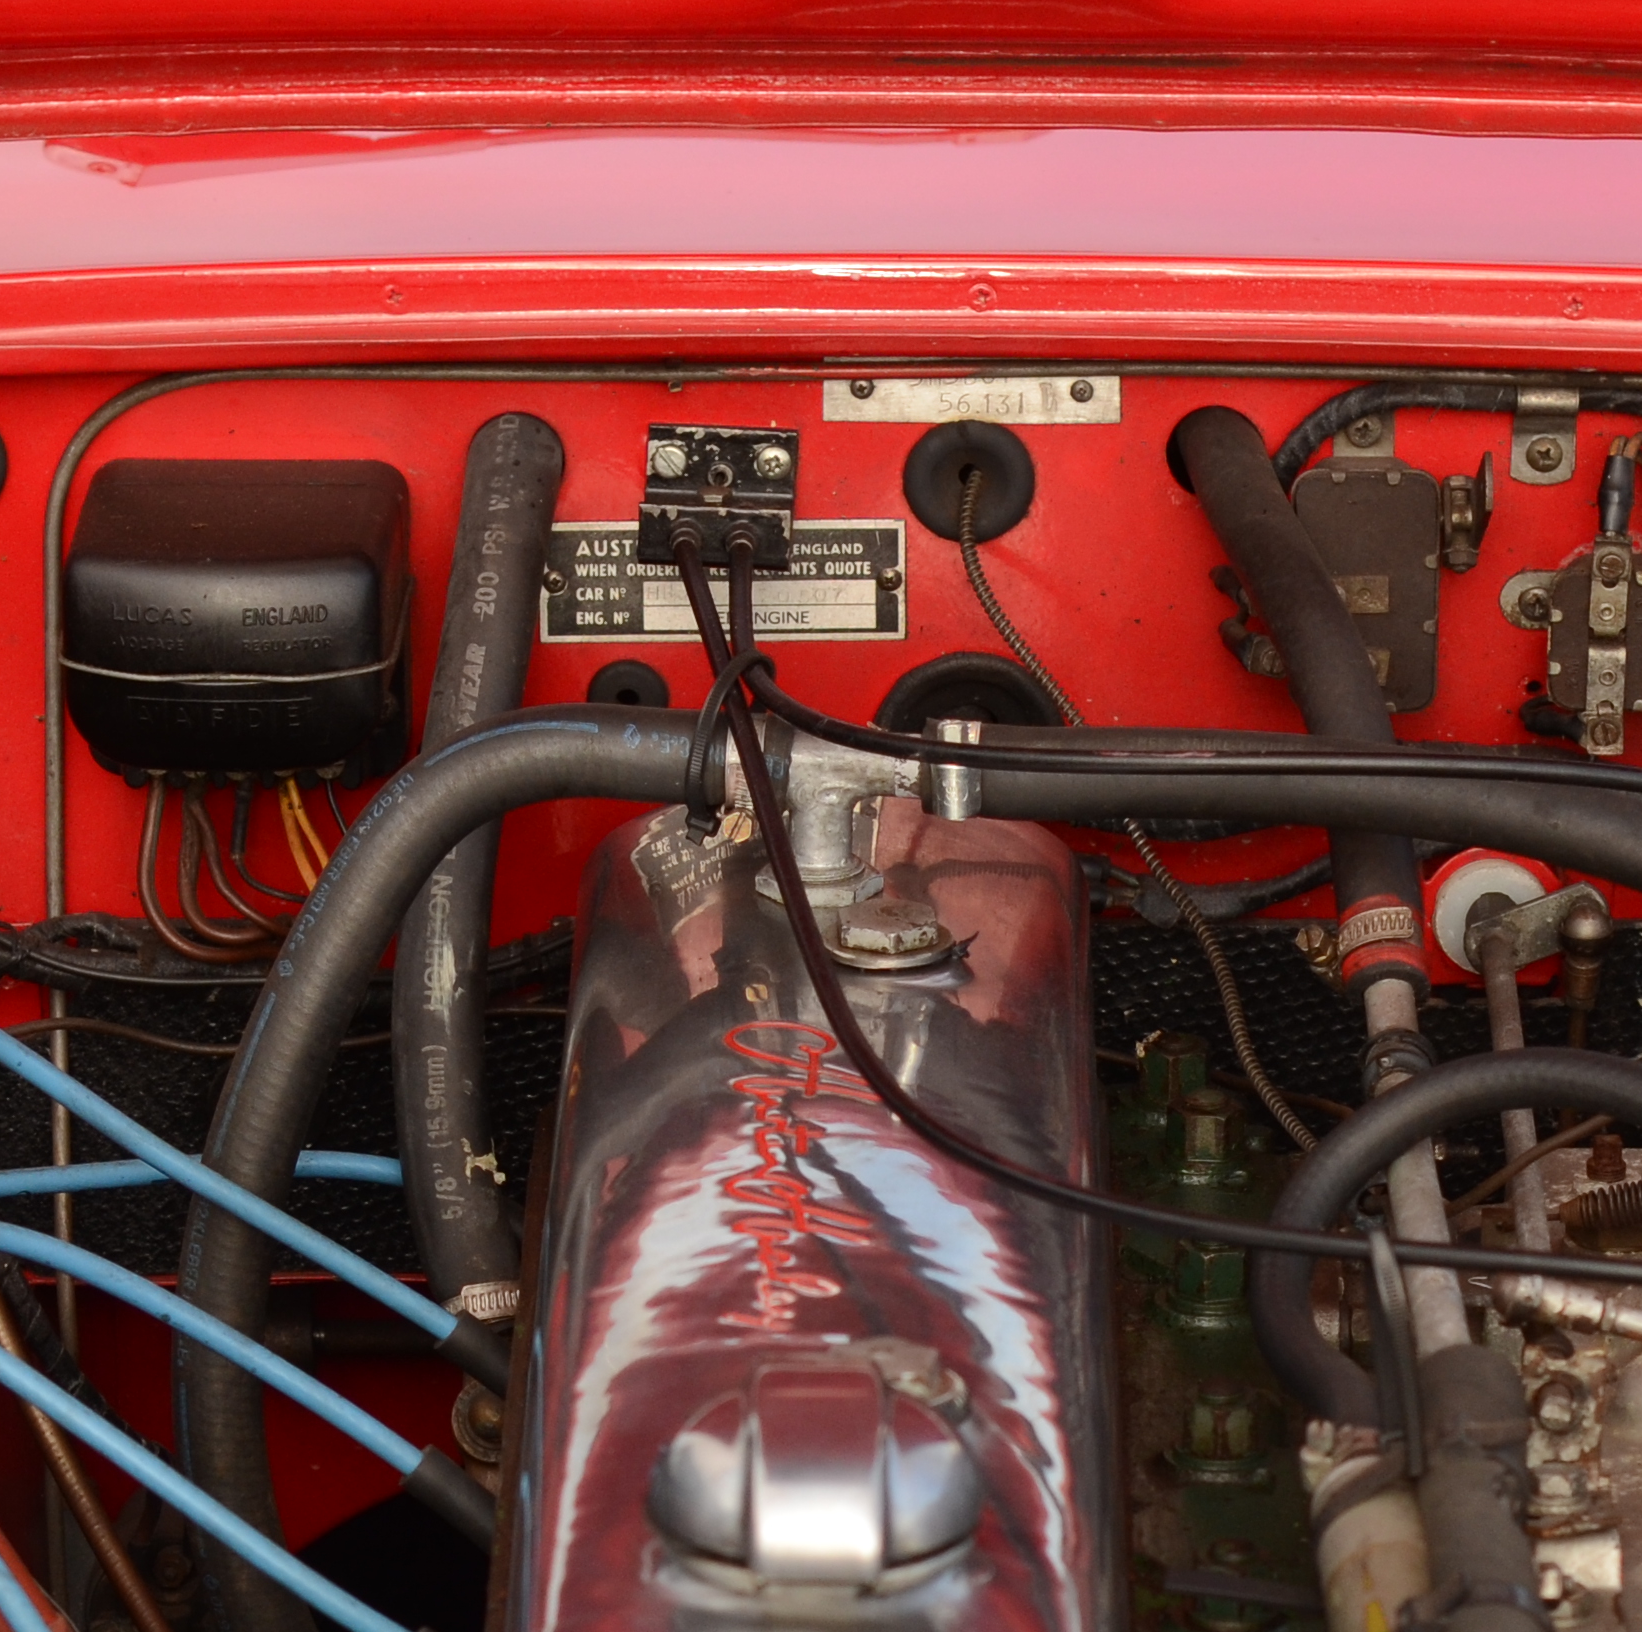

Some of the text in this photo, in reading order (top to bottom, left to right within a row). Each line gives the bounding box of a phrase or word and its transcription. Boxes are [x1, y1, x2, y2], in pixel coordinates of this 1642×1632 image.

[938, 393, 1025, 415] 56.131
[575, 539, 639, 557] AUST
[792, 543, 864, 556] ENGLAND
[574, 563, 618, 577] WHEN
[824, 561, 872, 576] QUOTE
[575, 587, 604, 601] CAR
[111, 603, 329, 627] LUCAS ENGLAND
[575, 611, 608, 625] ENG.
[753, 611, 811, 625] NGINE
[242, 636, 333, 653] REGULATOR
[287, 705, 301, 727] E
